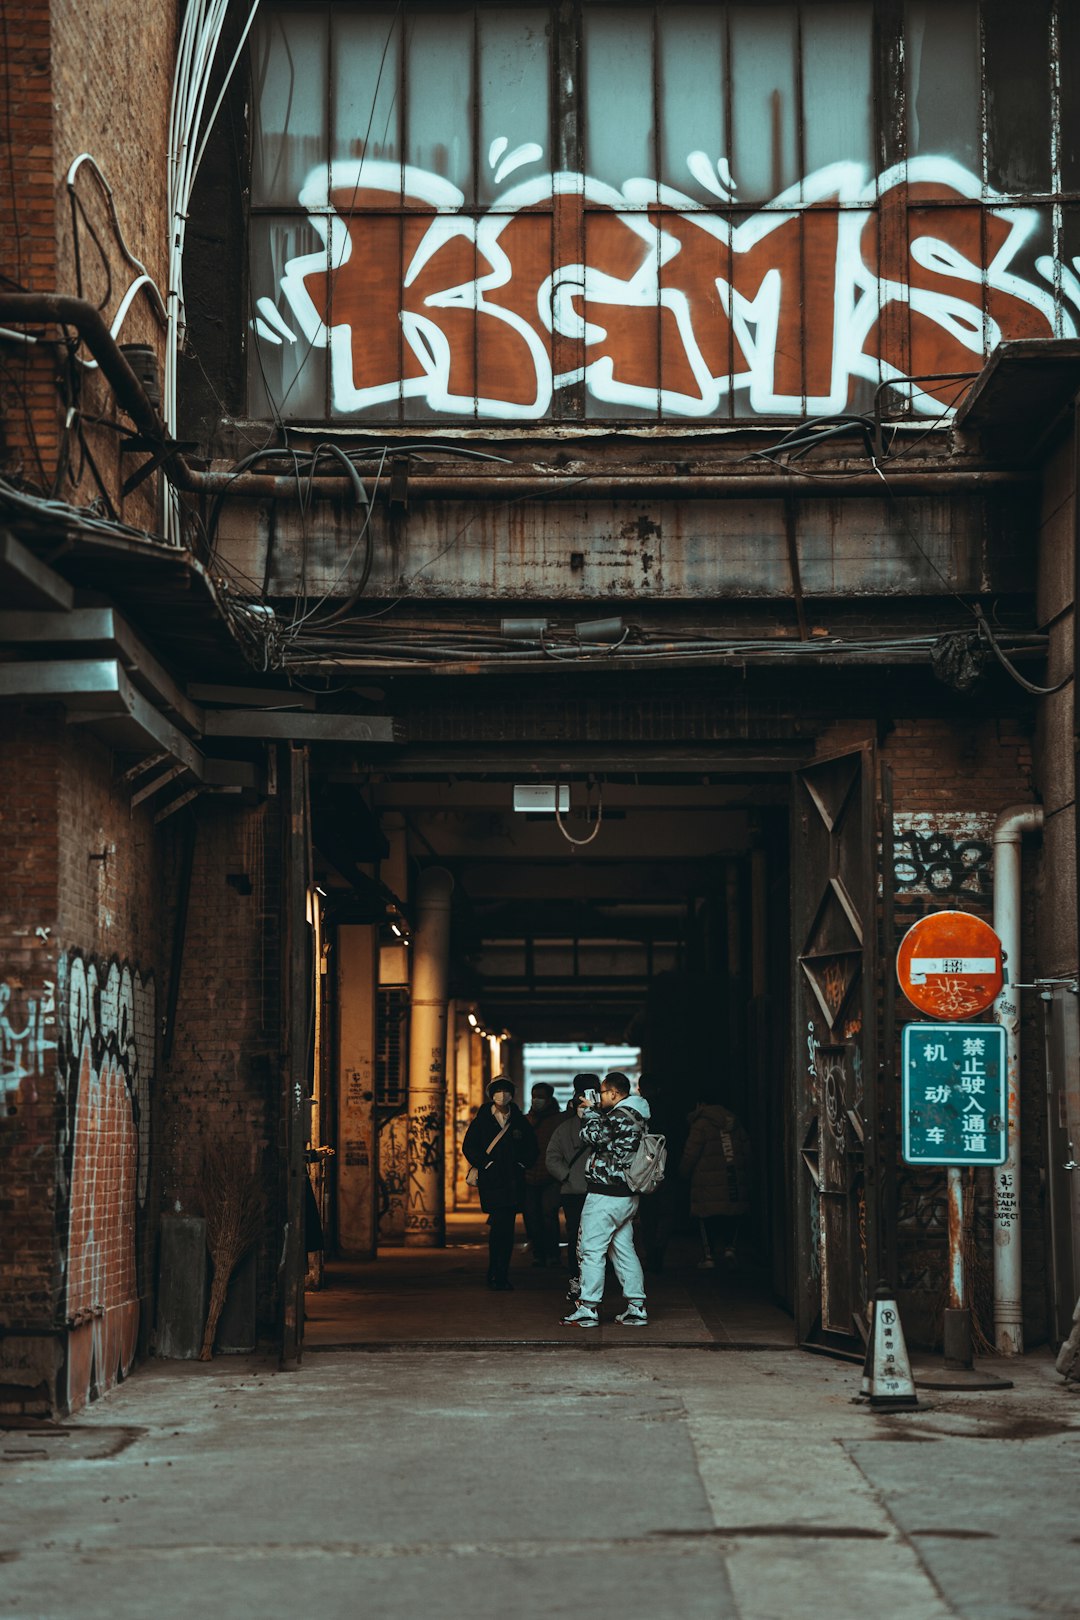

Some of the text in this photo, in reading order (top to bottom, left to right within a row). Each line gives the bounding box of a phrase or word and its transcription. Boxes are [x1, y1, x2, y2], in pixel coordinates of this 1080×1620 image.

[923, 1043, 948, 1145] 机动车
[961, 1037, 987, 1152] 禁止驶入通道
